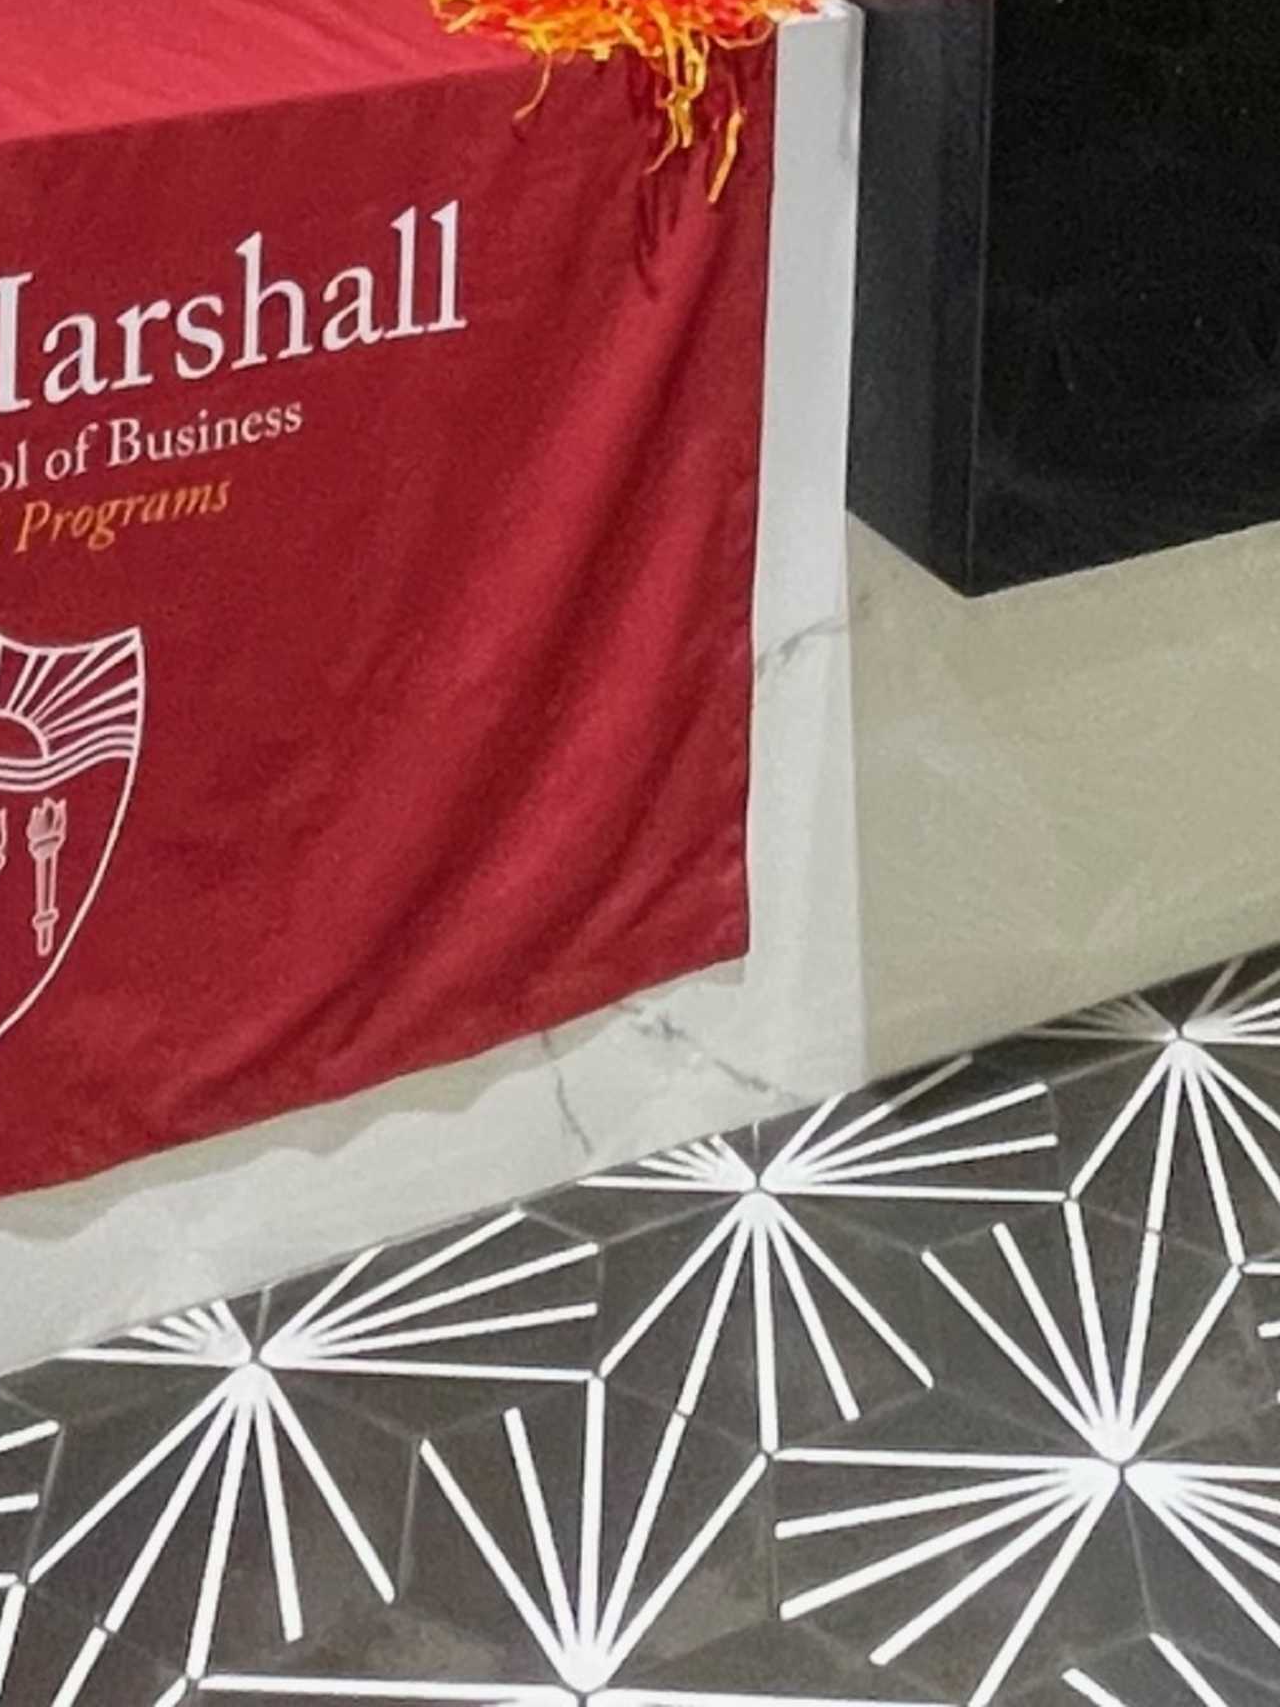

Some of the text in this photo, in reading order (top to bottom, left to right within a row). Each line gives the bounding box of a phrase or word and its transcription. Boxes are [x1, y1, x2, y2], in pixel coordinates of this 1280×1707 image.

[45, 423, 99, 480] of
[107, 400, 304, 467] Business
[14, 479, 230, 554] Programs
